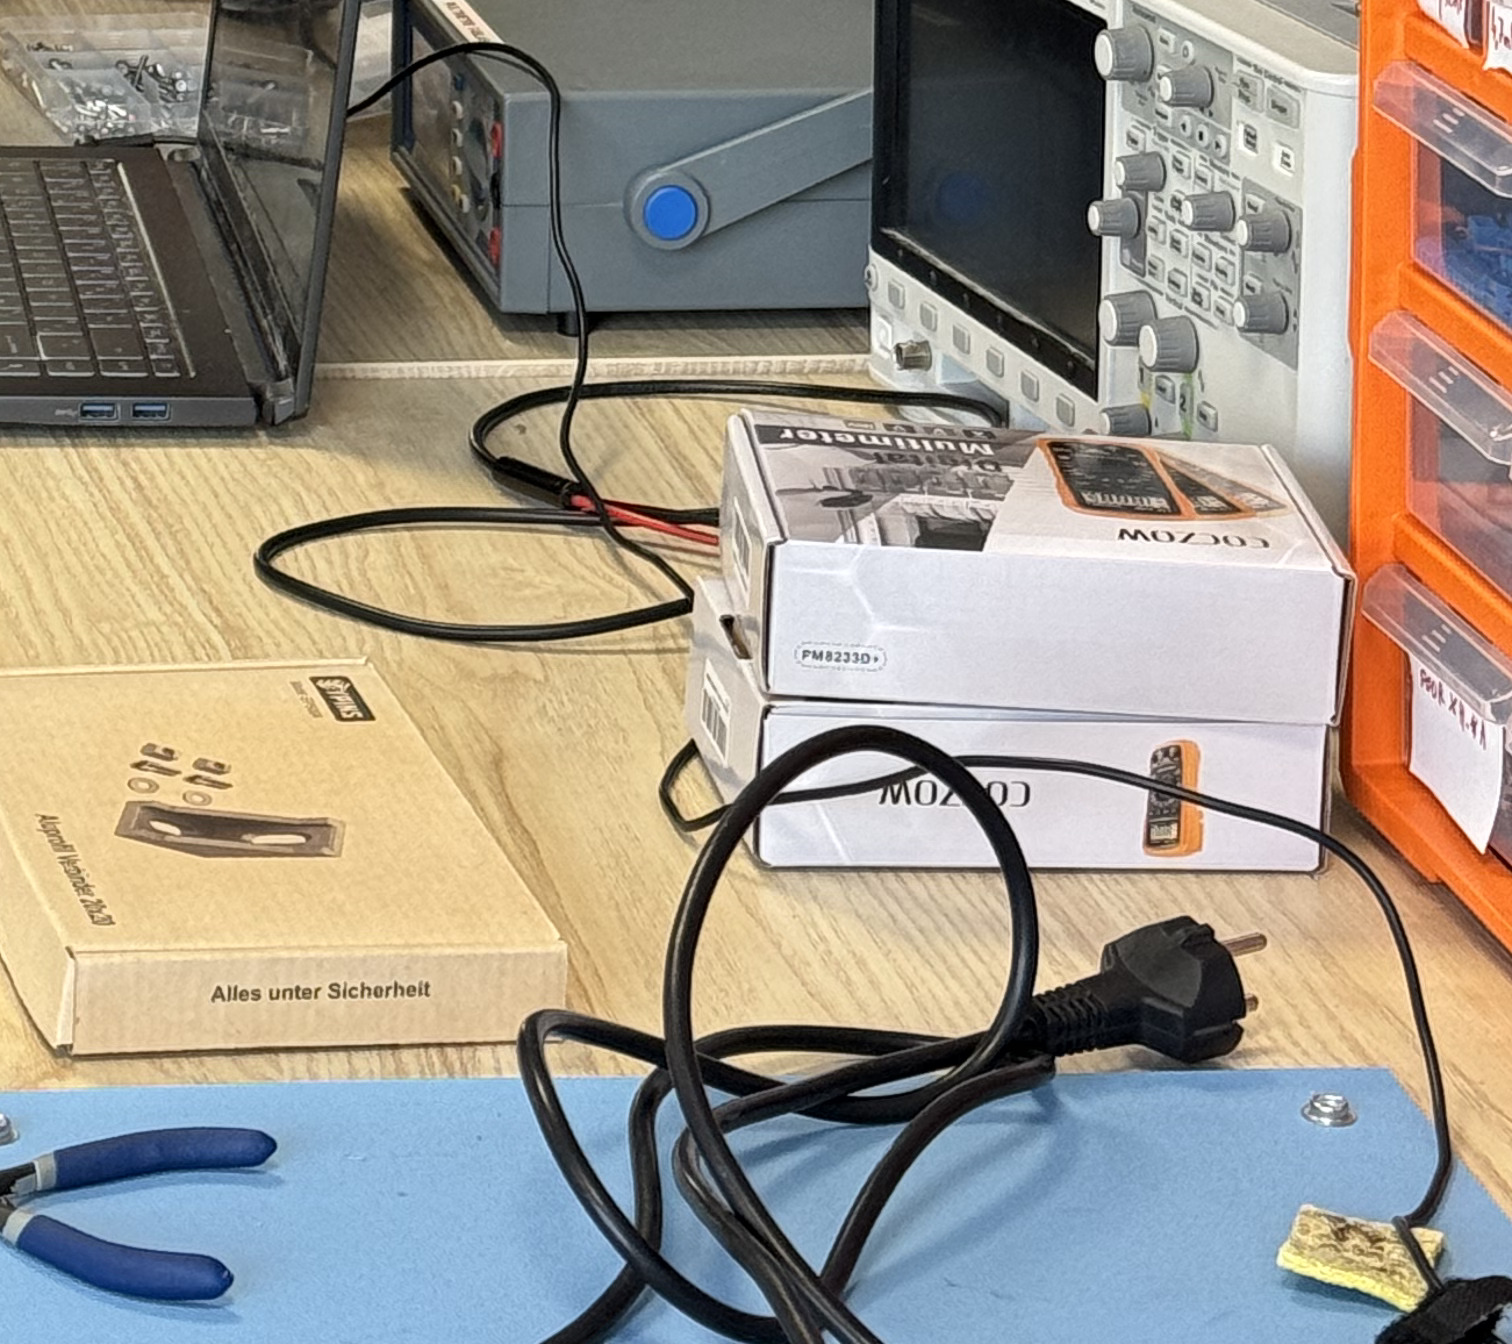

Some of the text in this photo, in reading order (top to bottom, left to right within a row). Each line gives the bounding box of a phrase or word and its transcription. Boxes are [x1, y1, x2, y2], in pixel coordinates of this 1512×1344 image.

[779, 427, 995, 457] Multimeter
[211, 981, 431, 1003] Alles unter Sicherheit
